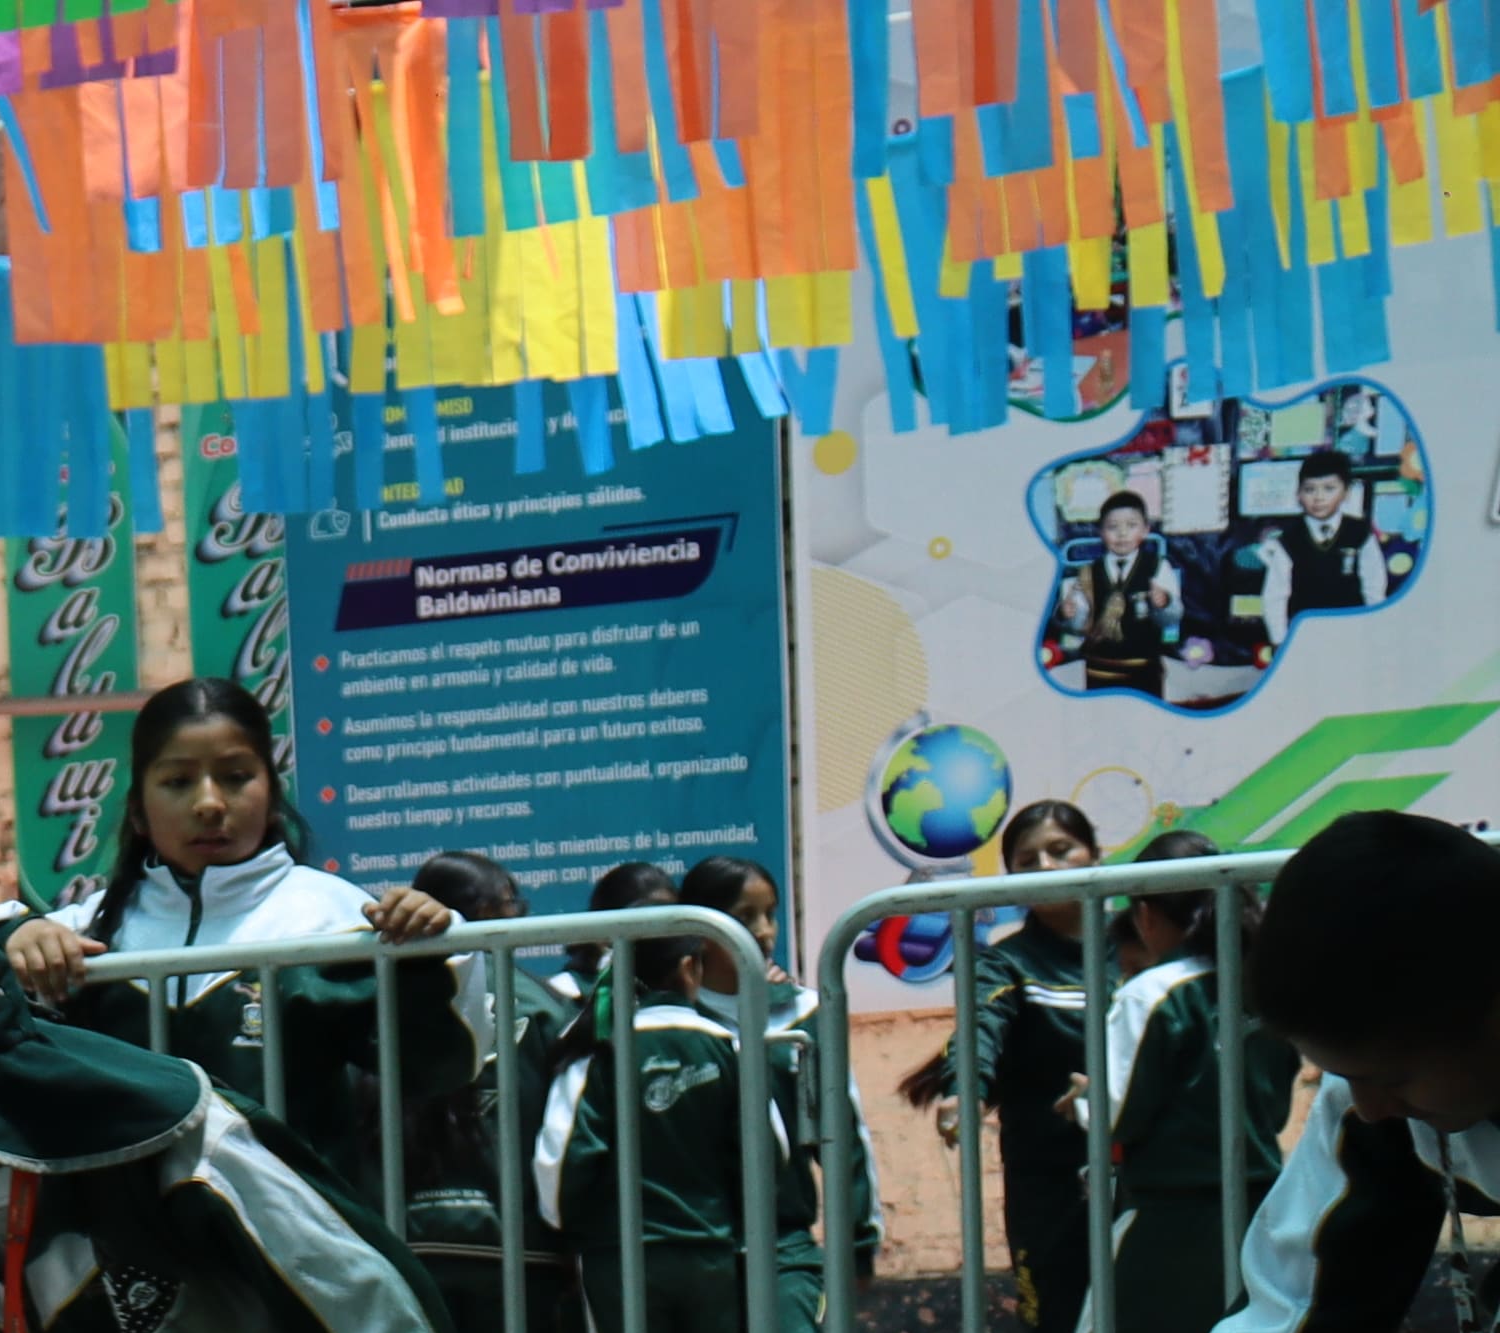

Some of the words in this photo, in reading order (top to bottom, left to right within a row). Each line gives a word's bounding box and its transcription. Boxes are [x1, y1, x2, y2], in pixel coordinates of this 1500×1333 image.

[382, 396, 473, 424] OMMISO
[450, 418, 519, 443] instituci
[378, 509, 448, 530] Conducta
[452, 500, 491, 523] ética
[494, 503, 504, 521] y
[508, 491, 583, 518] principios
[587, 483, 647, 505] sólidos.
[380, 477, 465, 502] NTEGAD
[415, 559, 507, 589] Normas
[512, 556, 543, 578] de
[547, 538, 700, 576] Conviviencia
[416, 586, 562, 619] Baldwiniana
[341, 647, 428, 668] Practicamos
[431, 642, 445, 660] el
[449, 638, 501, 659] respeto
[506, 634, 551, 651] mutuo
[555, 631, 587, 651] para
[592, 623, 654, 645] disfrutar
[659, 619, 676, 638] de
[681, 620, 700, 637] un
[342, 675, 406, 697] ambiente
[410, 674, 428, 690] en
[432, 664, 490, 688] armonía
[493, 668, 503, 687] y
[506, 658, 557, 681] calidad
[561, 656, 579, 675] de
[583, 653, 617, 674] vida.
[343, 712, 417, 735] Asumimos
[420, 710, 433, 728] la
[438, 699, 549, 727] responsabilidad
[552, 699, 578, 716] con
[583, 692, 645, 714] nuestros
[650, 687, 709, 707] deberes
[345, 745, 383, 763] como
[386, 736, 447, 760] principio
[450, 727, 540, 753] fundamental
[543, 727, 576, 748] para
[580, 724, 598, 741] un
[602, 719, 647, 740] futuro
[651, 714, 706, 735] exitoso.
[347, 780, 449, 802] Desarrollamos
[452, 769, 532, 794] actividades
[535, 770, 561, 787] con
[564, 758, 654, 788] puntualidad,
[657, 752, 749, 780] organizando
[348, 809, 401, 831] nuestro
[405, 805, 453, 826] tiempo
[455, 807, 465, 826] y
[468, 799, 534, 819] recursos.
[350, 851, 397, 873] Somos
[493, 839, 530, 859] todos
[534, 838, 556, 857] los
[559, 833, 632, 855] miembros
[635, 830, 652, 849] de
[656, 829, 670, 847] la
[674, 821, 759, 846] comunidad,
[562, 864, 587, 882] con
